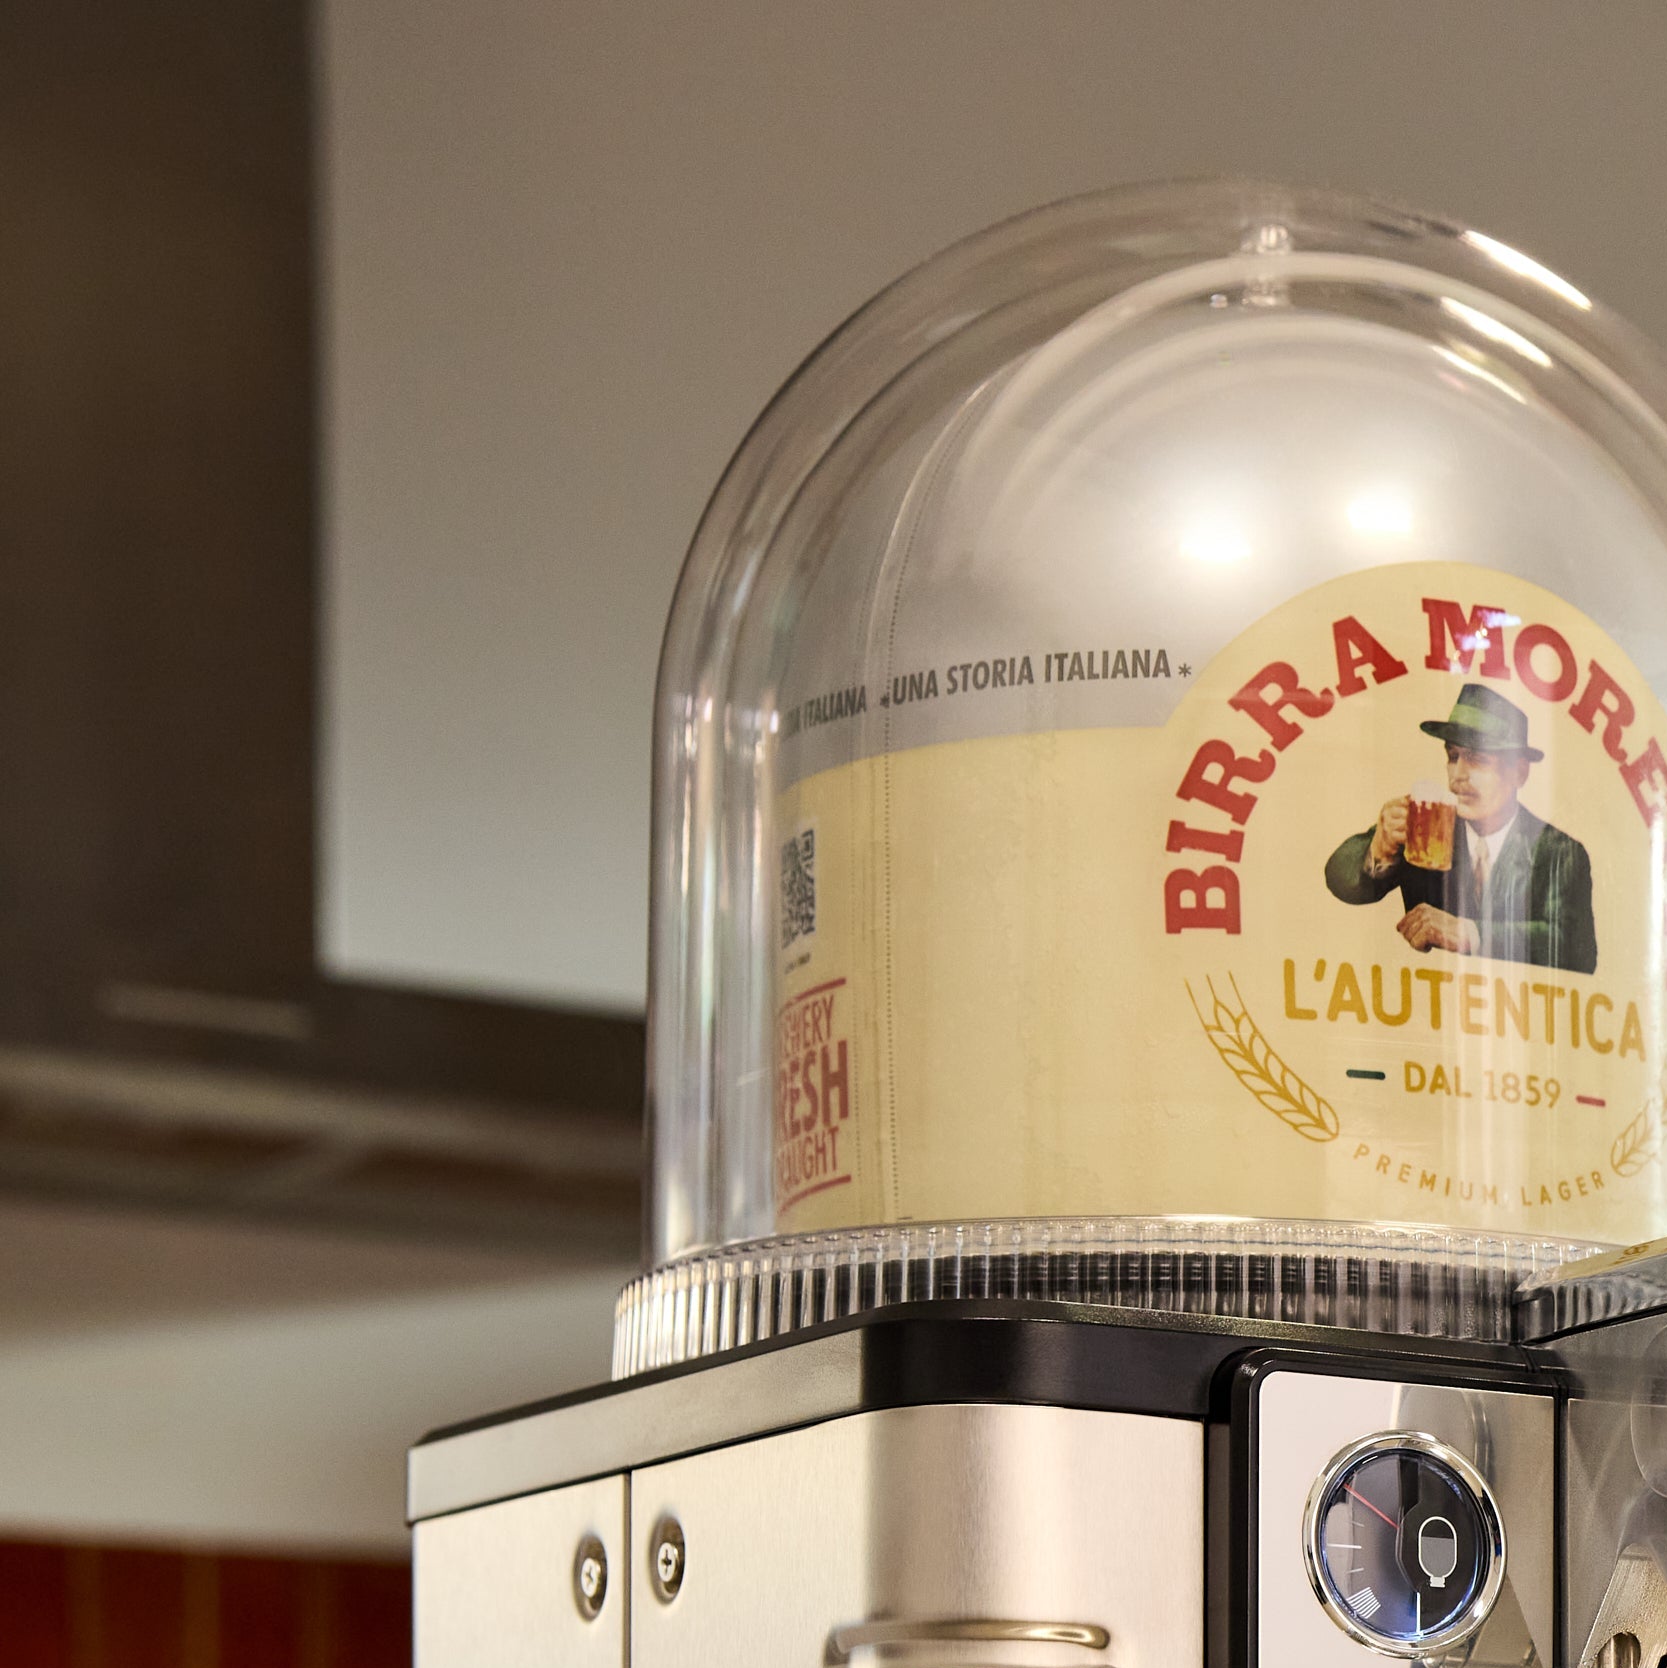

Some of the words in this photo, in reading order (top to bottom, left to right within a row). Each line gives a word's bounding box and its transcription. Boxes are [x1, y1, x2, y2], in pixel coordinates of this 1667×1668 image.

[892, 669, 939, 705] UNA
[946, 655, 1034, 696] STORIA
[1044, 649, 1171, 683] ITALIANA
[1164, 616, 1408, 936] BIRRA
[1283, 958, 1646, 1062] L'AUTENTICA
[1403, 1061, 1472, 1099] DAL
[1484, 1069, 1562, 1109] 1859
[1353, 1143, 1498, 1205] PREMIUM
[1521, 1170, 1605, 1206] LAGER
